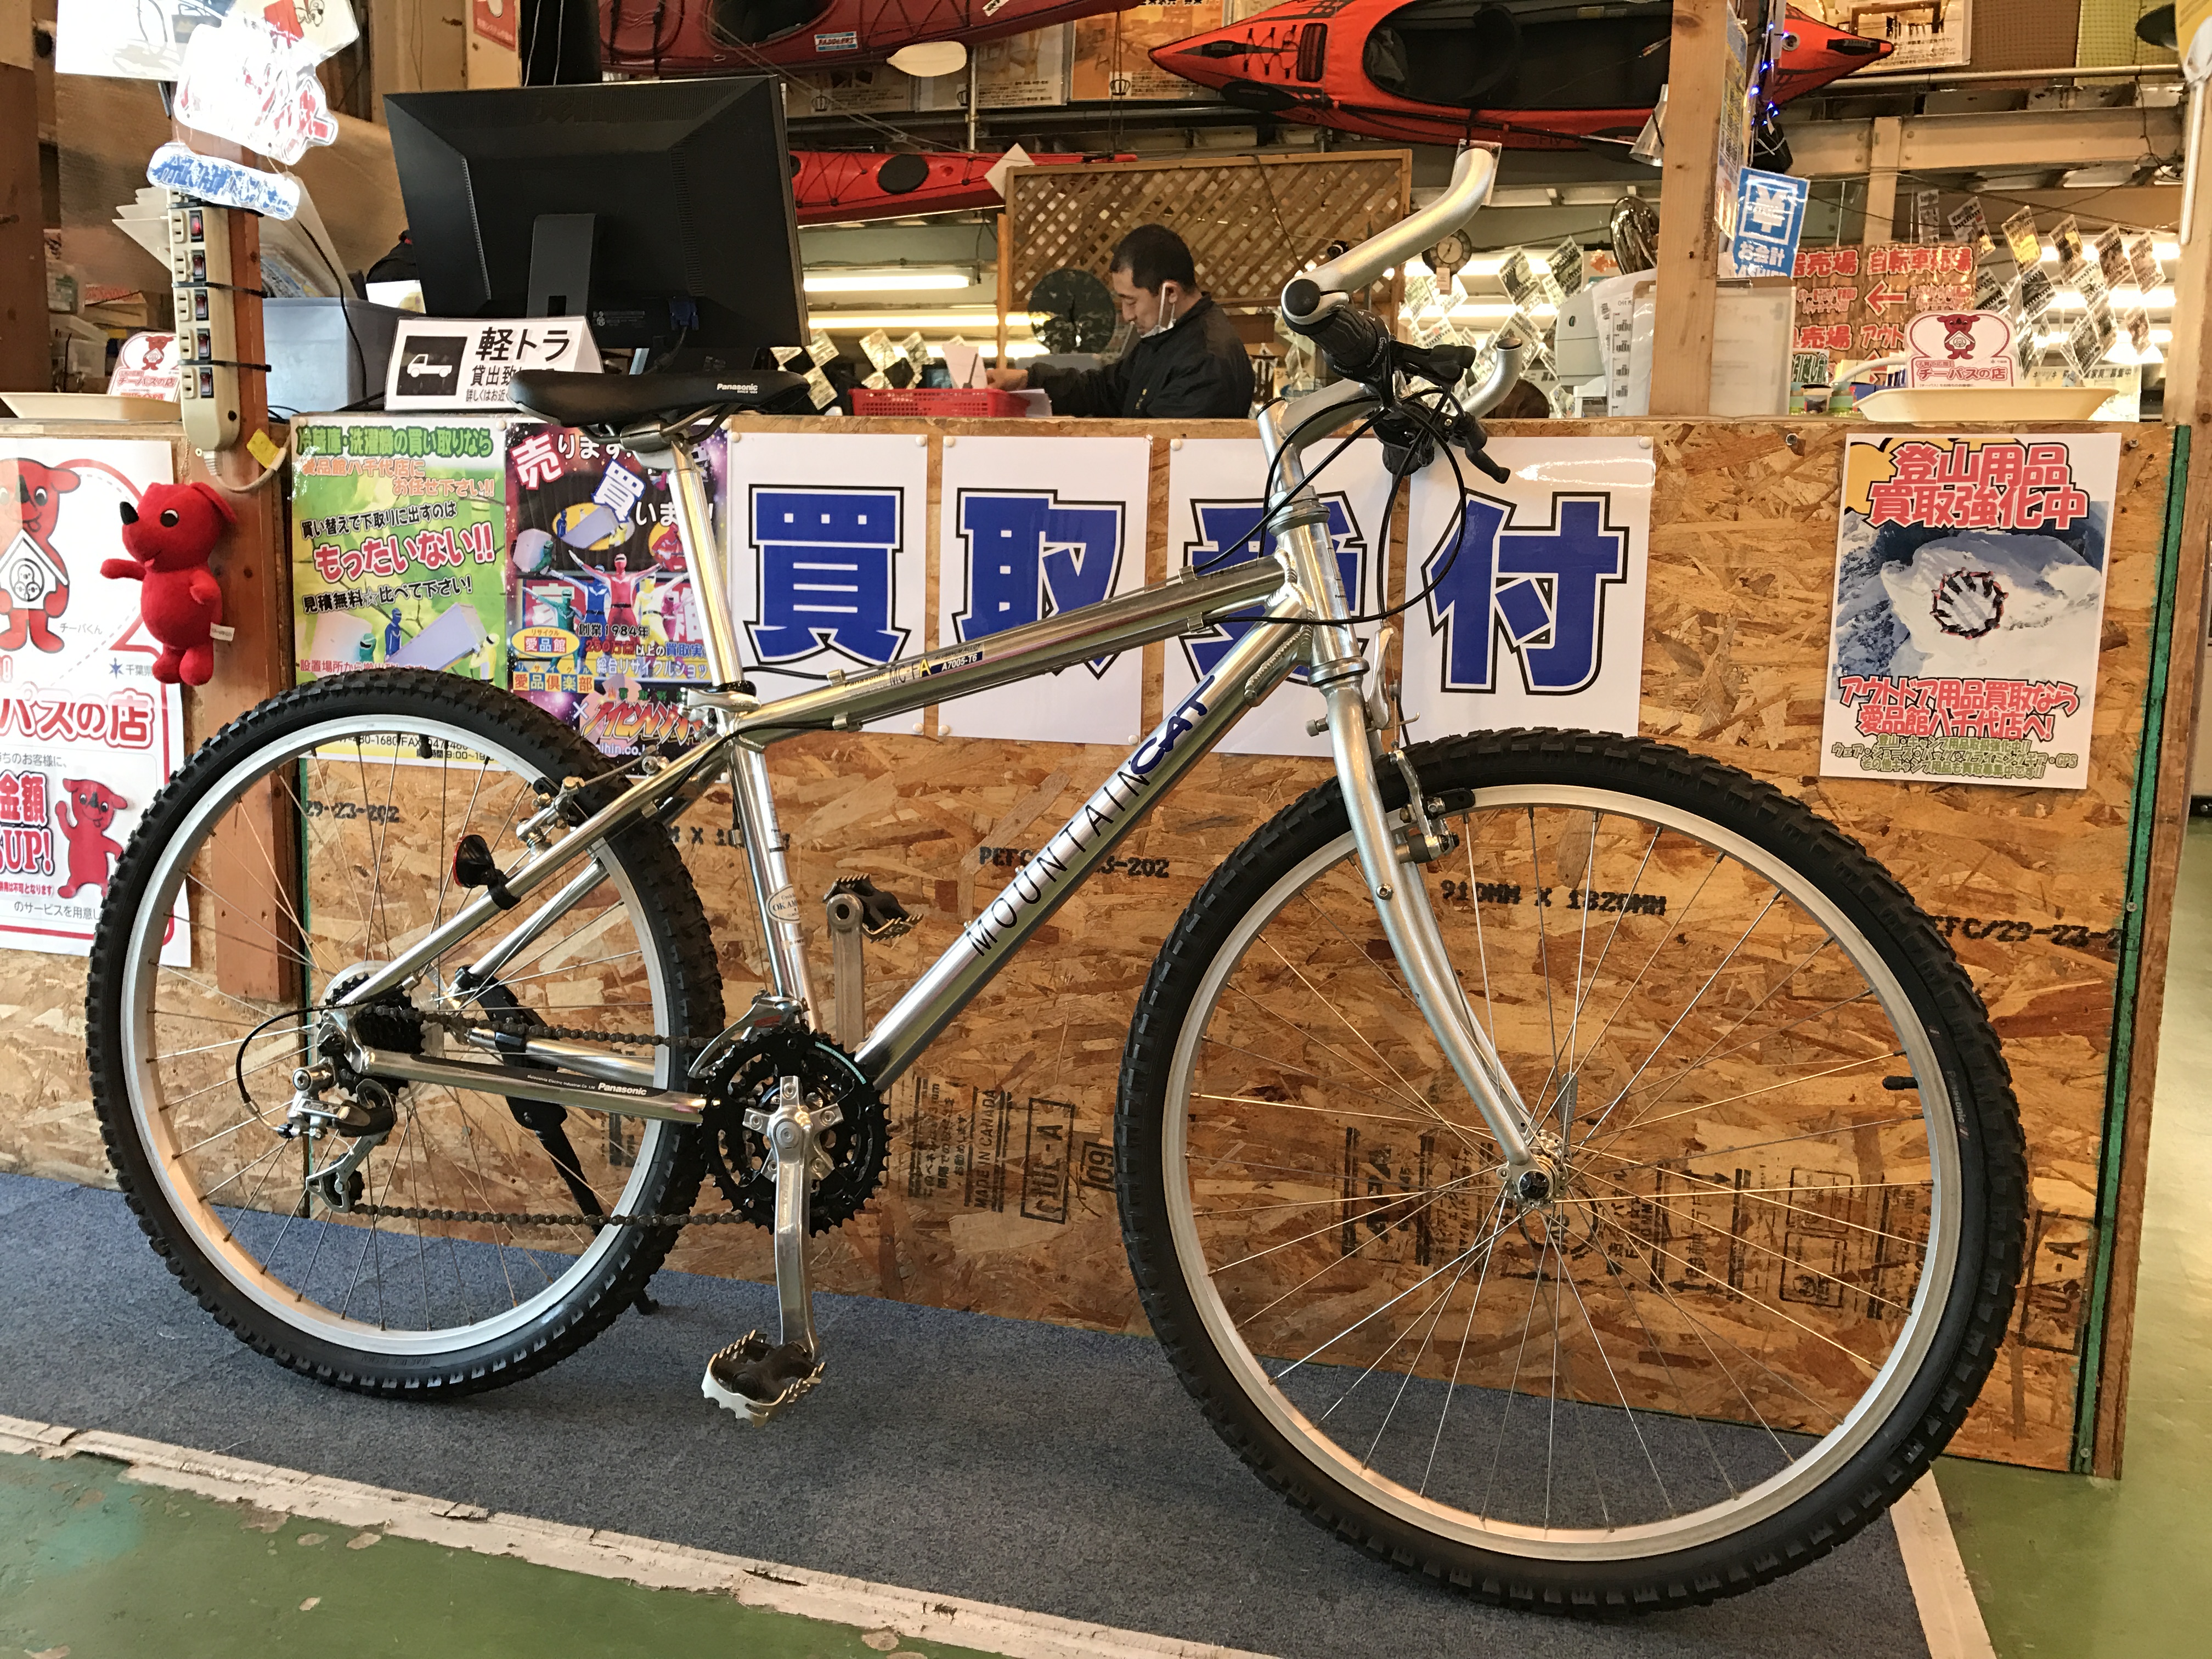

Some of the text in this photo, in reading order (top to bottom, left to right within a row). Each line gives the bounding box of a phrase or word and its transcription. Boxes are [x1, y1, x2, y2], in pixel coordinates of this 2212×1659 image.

[1867, 247, 1973, 276] 自転車売場
[476, 326, 571, 362] 軽トラ
[1793, 324, 1853, 351] 売場
[1860, 323, 1904, 348] アウト
[470, 365, 524, 386] 貸出致
[1917, 366, 2008, 381] チーパスの店
[1888, 442, 2071, 487] 登山用品
[301, 501, 458, 539] 買い替えで下取りに出すのは
[1866, 482, 2091, 531] 買取強化中
[578, 623, 650, 638] 創業1984年
[524, 636, 567, 653] 愛品館
[596, 658, 708, 680] 総合リサイクルショッ
[941, 653, 978, 672] A7005-T6
[514, 672, 594, 692] 愛品倶楽部
[845, 673, 886, 687] Panasonic
[1838, 675, 2080, 716] アウトドア用品買取なら
[1856, 704, 2056, 742] 愛品館八千代店へ!
[966, 674, 1215, 957] MOUNTAIN CAT
[0, 827, 54, 876] UP!
[598, 1082, 647, 1096] Panasonic
[974, 1089, 996, 1208] MADE IN CANADA
